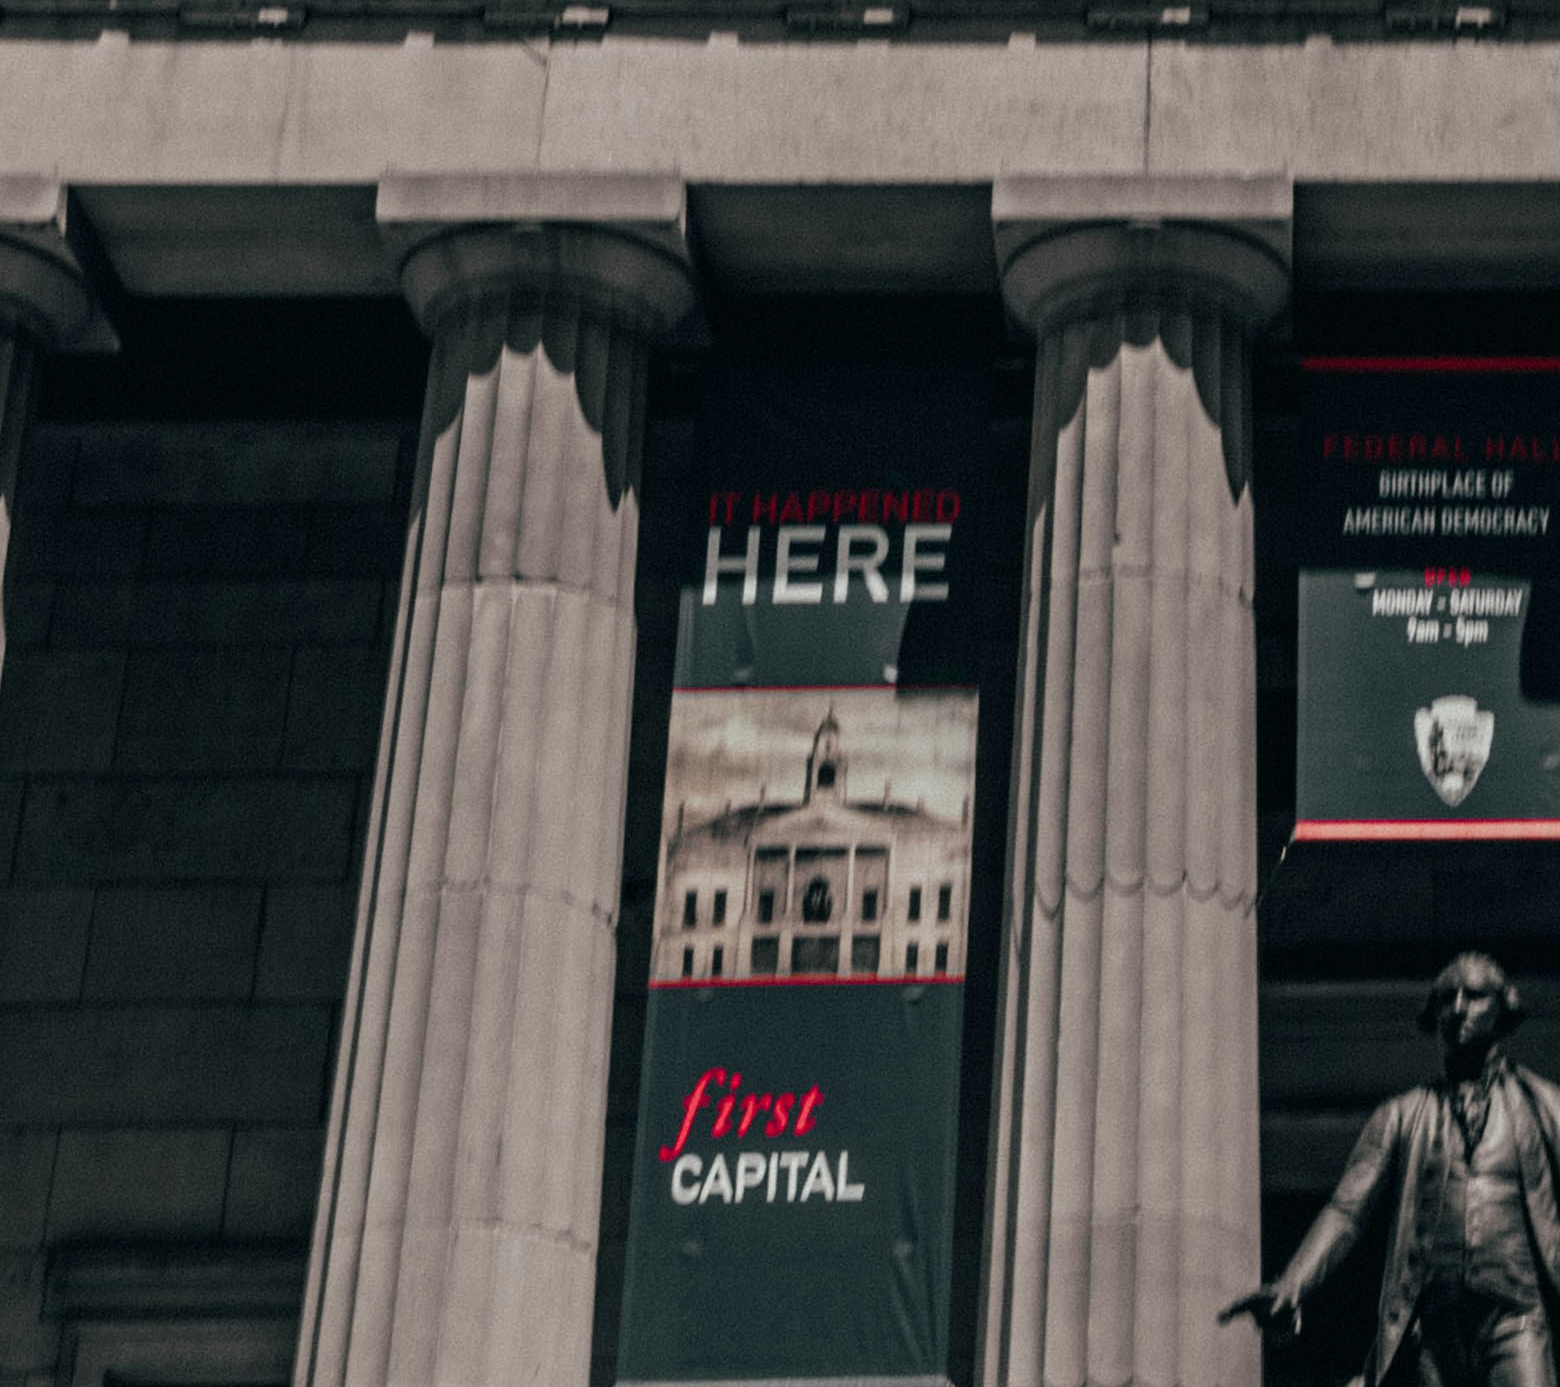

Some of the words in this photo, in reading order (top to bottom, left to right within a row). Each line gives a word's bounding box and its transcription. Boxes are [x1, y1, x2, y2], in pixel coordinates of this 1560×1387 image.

[1323, 433, 1469, 462] FEDERAL
[1379, 468, 1486, 499] BIRTHPLACE
[1491, 468, 1514, 499] OF
[709, 489, 742, 524] IT
[753, 488, 961, 524] HAPPENED
[1343, 506, 1436, 536] AMERICAN
[1441, 506, 1550, 536] DEMOCRACY
[702, 523, 953, 606] HERE
[1372, 588, 1433, 617] MONDAY
[1450, 588, 1522, 617] SATURDAY
[659, 1067, 824, 1162] first
[671, 1150, 865, 1205] CAPITAL
